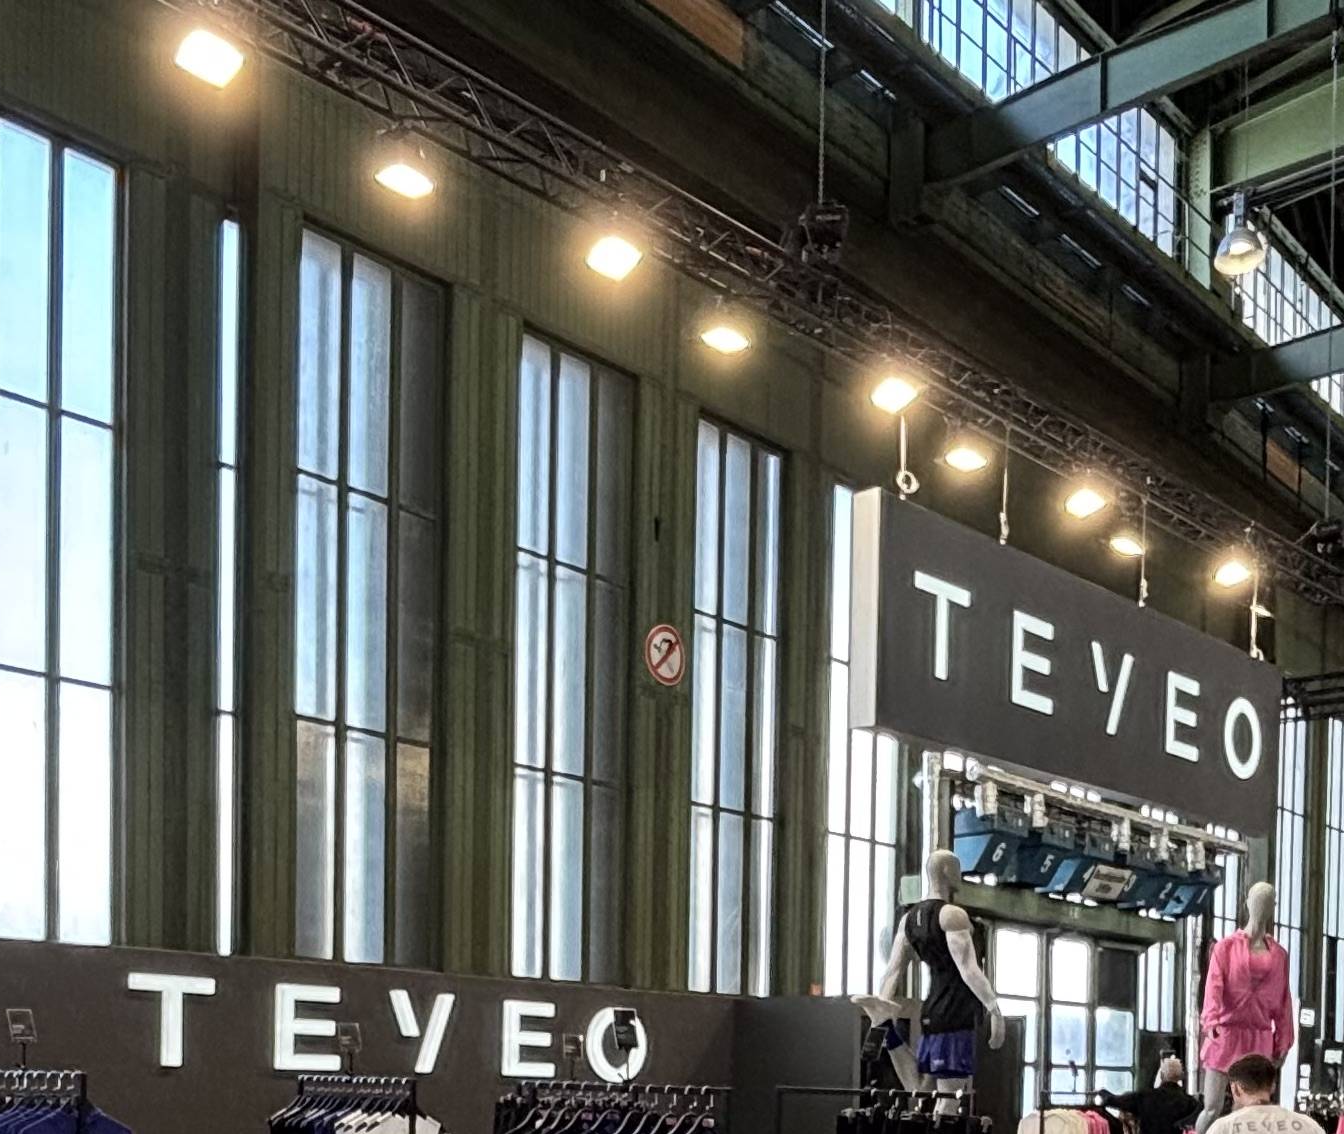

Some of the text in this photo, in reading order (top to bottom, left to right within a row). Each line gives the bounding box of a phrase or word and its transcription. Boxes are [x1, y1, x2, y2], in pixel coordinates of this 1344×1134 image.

[913, 570, 1263, 780] TEVEO
[992, 841, 1006, 863] 6
[1040, 854, 1055, 874] 5
[127, 971, 649, 1084] TEVEO
[1233, 1120, 1302, 1134] TEVEO
